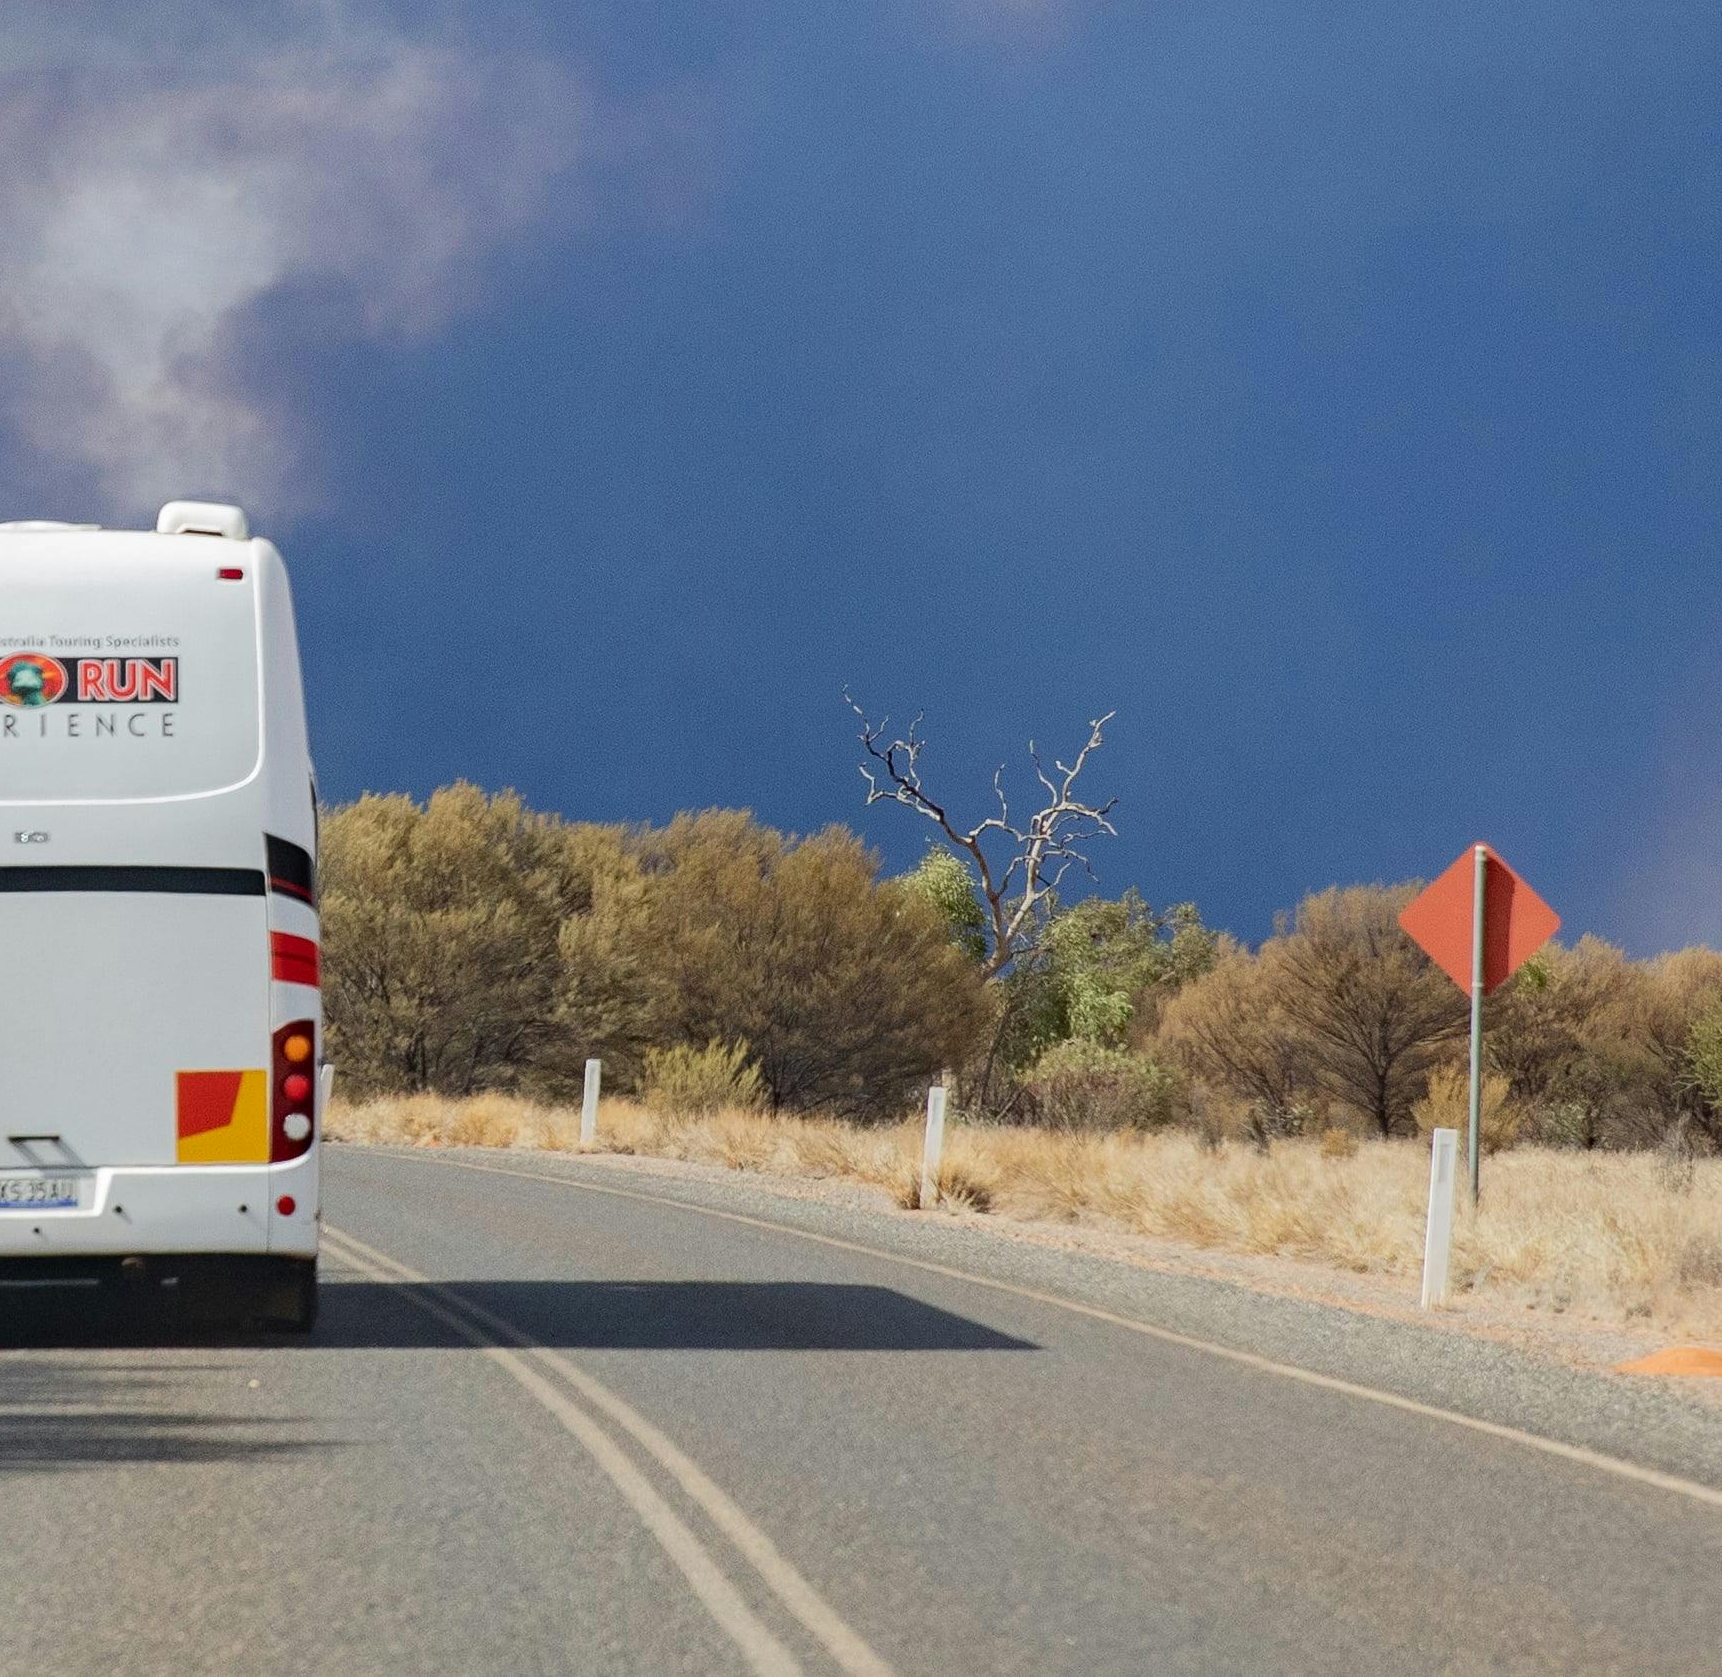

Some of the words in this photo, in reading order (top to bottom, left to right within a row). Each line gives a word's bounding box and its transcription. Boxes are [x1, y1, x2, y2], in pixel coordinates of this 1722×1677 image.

[49, 635, 101, 650] Touring
[105, 634, 180, 649] Specialists
[77, 659, 177, 702] RUN
